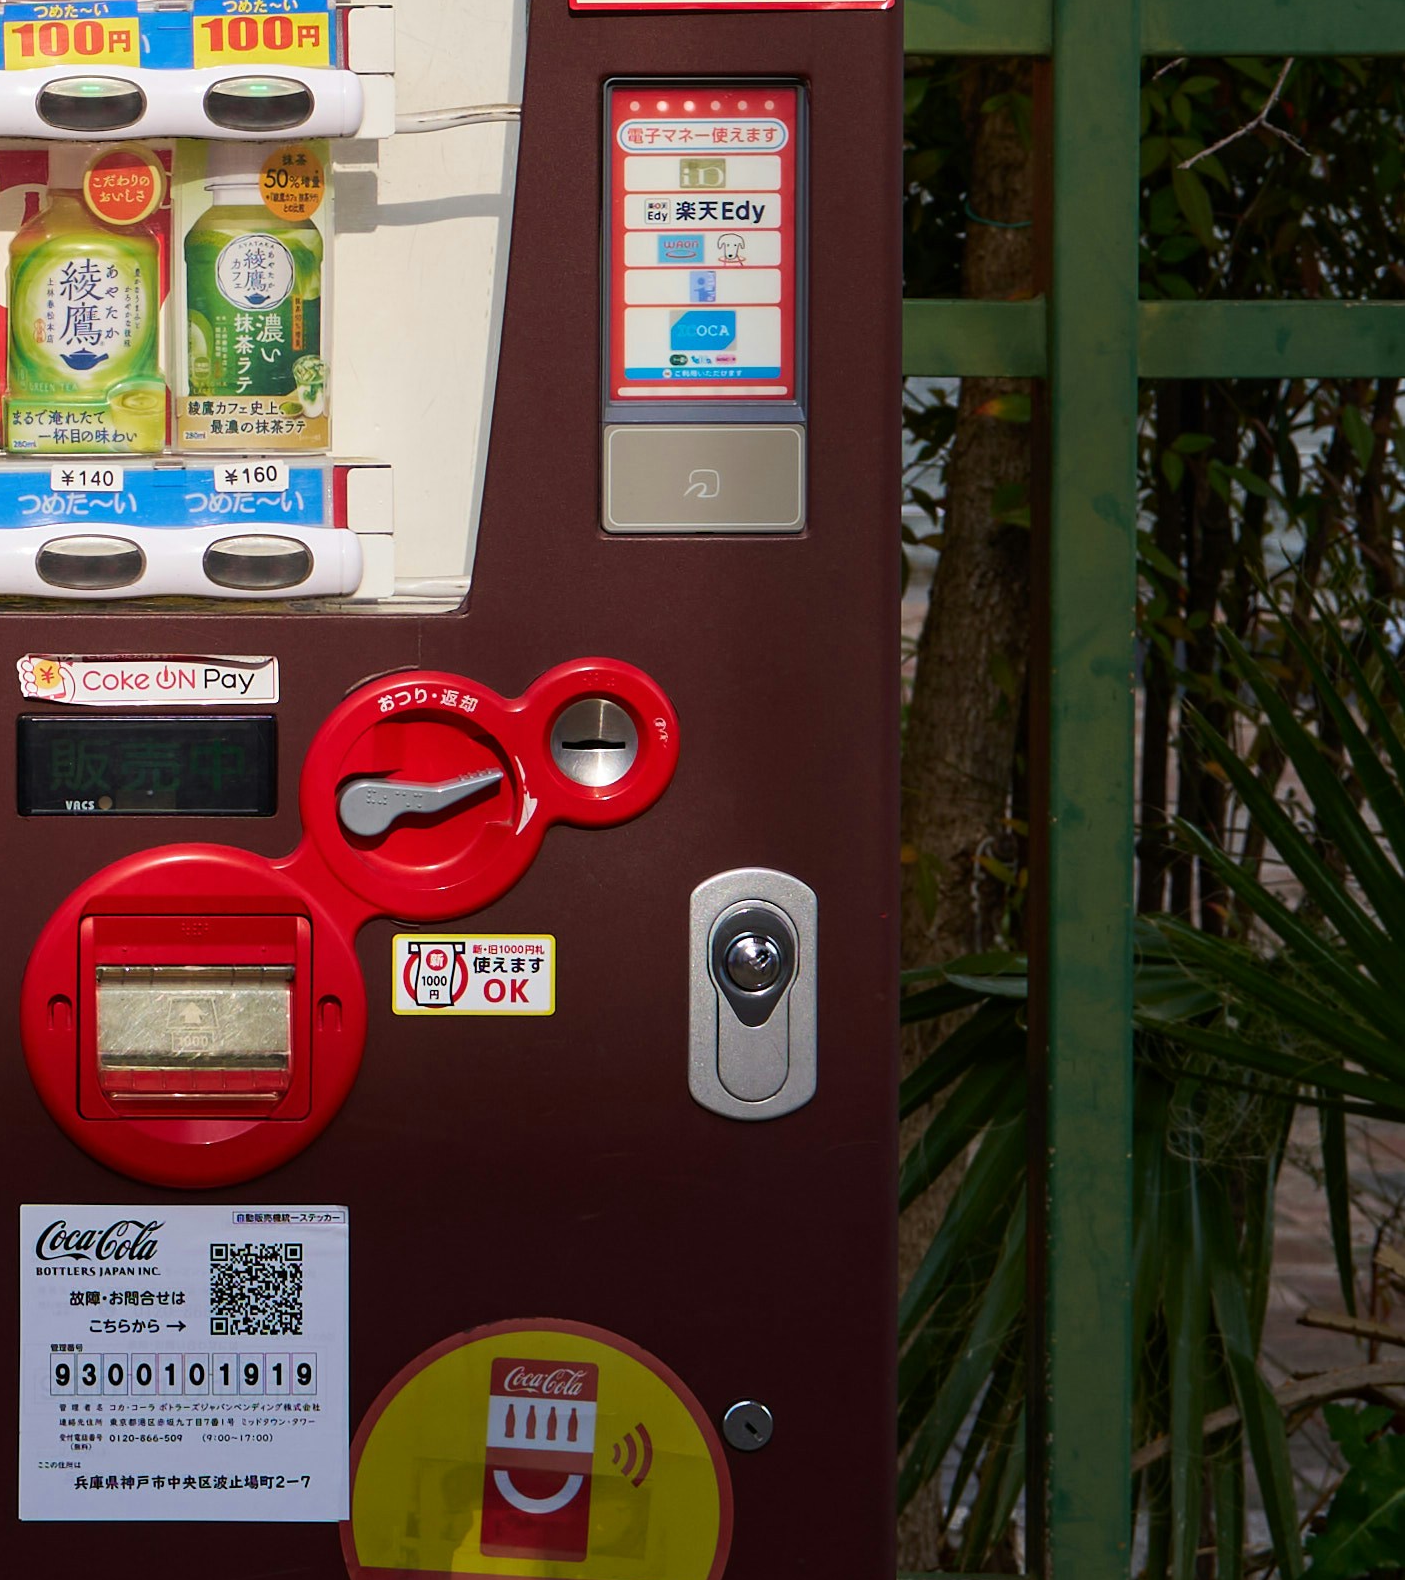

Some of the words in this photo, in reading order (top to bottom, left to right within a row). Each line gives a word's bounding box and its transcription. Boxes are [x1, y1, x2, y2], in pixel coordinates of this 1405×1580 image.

[11, 24, 131, 56] 100円
[627, 127, 778, 143] 電子マネー使えます
[676, 201, 765, 224] 楽天Edy
[210, 419, 305, 434] 最濃の抹茶ラテ
[225, 467, 278, 484] ¥160
[83, 668, 150, 692] Coke
[156, 665, 196, 691] ON
[202, 668, 255, 695] Pay
[377, 688, 478, 713] おつり・返却
[50, 737, 247, 792] 販売中
[473, 944, 544, 955] 新・旧1000円札
[473, 955, 545, 974] 使えます
[484, 979, 530, 1004] OK
[37, 1267, 96, 1276] BOTTLERS
[99, 1267, 134, 1277] JAPAN
[138, 1267, 161, 1276] INC.
[70, 1291, 185, 1306] 故障・お問合せは
[89, 1320, 159, 1332] こちらから
